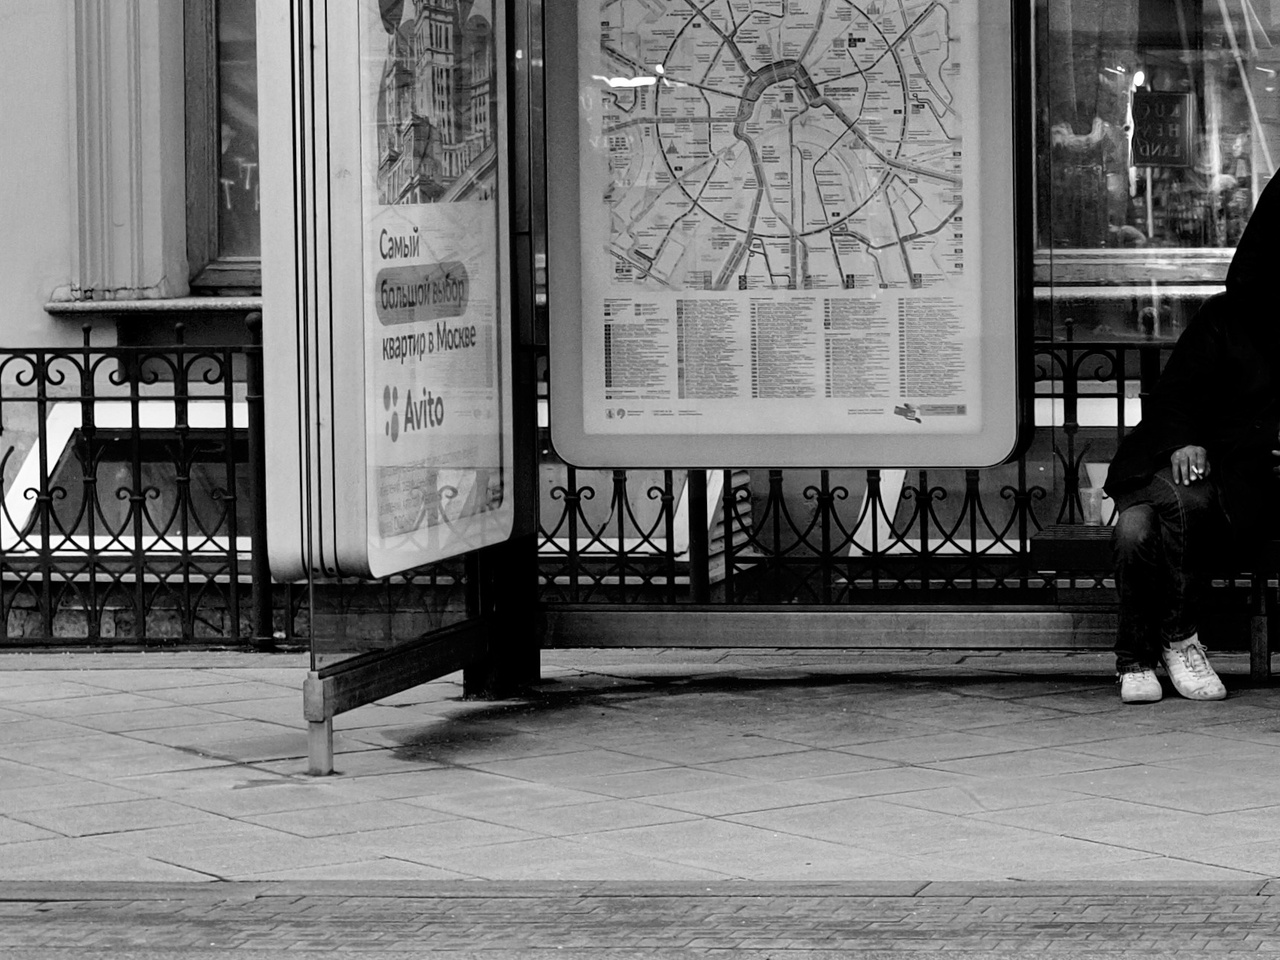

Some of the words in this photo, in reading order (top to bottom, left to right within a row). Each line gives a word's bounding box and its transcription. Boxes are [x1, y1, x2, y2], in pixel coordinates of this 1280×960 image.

[379, 226, 420, 260] Самый
[380, 274, 430, 310] большой
[432, 272, 465, 308] выбор
[382, 332, 425, 365] квартир
[428, 331, 435, 354] в
[436, 321, 477, 352] Москве
[404, 386, 444, 433] Avito
